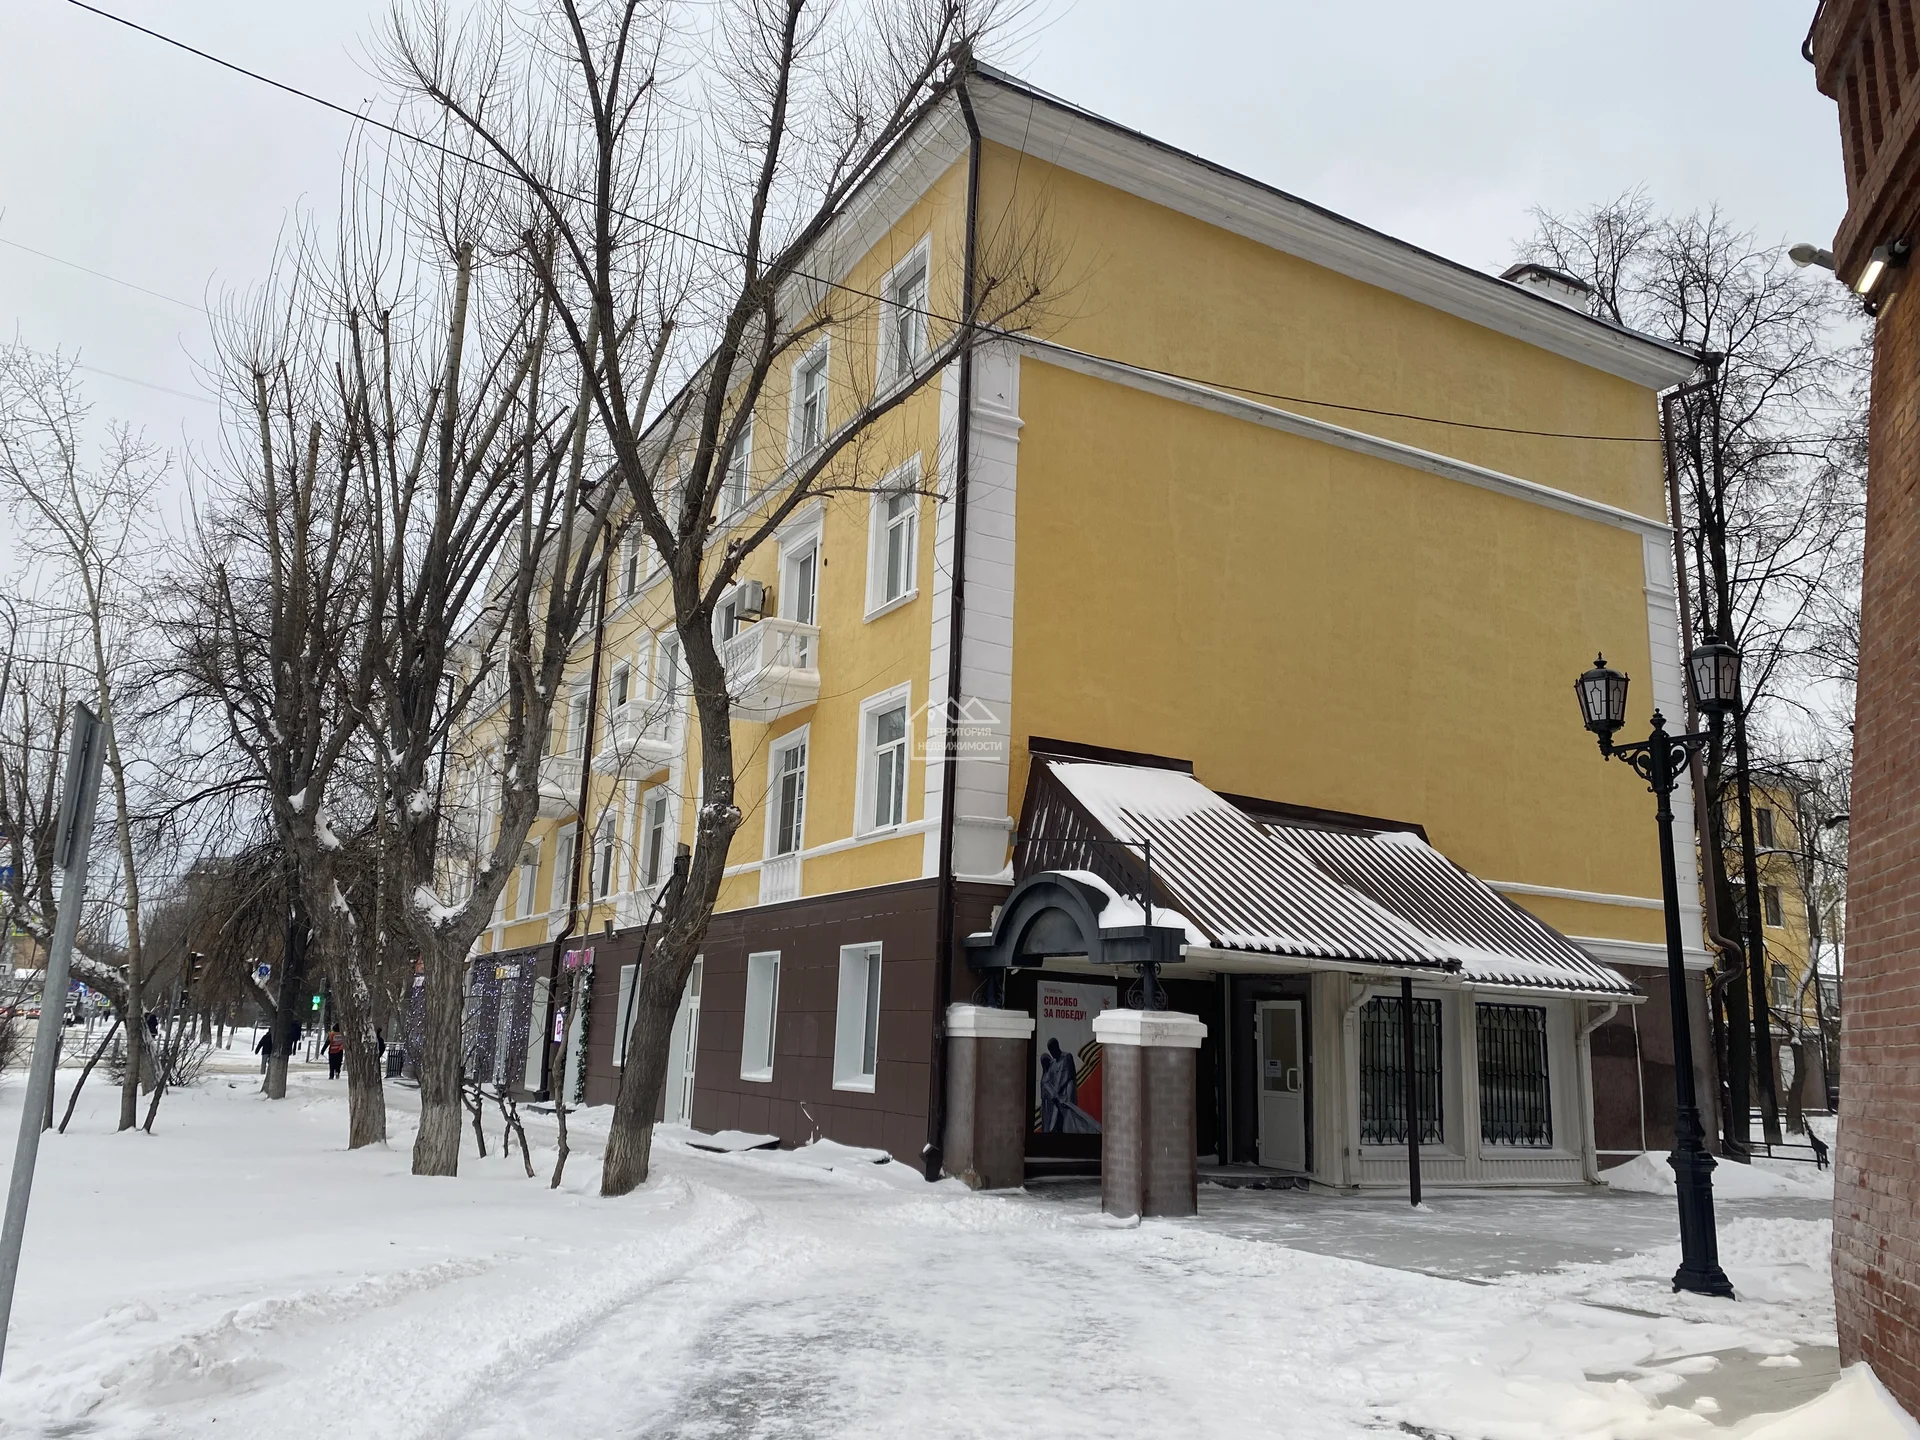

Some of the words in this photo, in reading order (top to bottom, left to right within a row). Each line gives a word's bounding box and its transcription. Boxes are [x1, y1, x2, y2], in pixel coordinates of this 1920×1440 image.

[1044, 996, 1078, 1007] СПАСИБО
[1044, 1008, 1053, 1018] ЗА
[1056, 1009, 1087, 1021] ПОБЕДУ!
